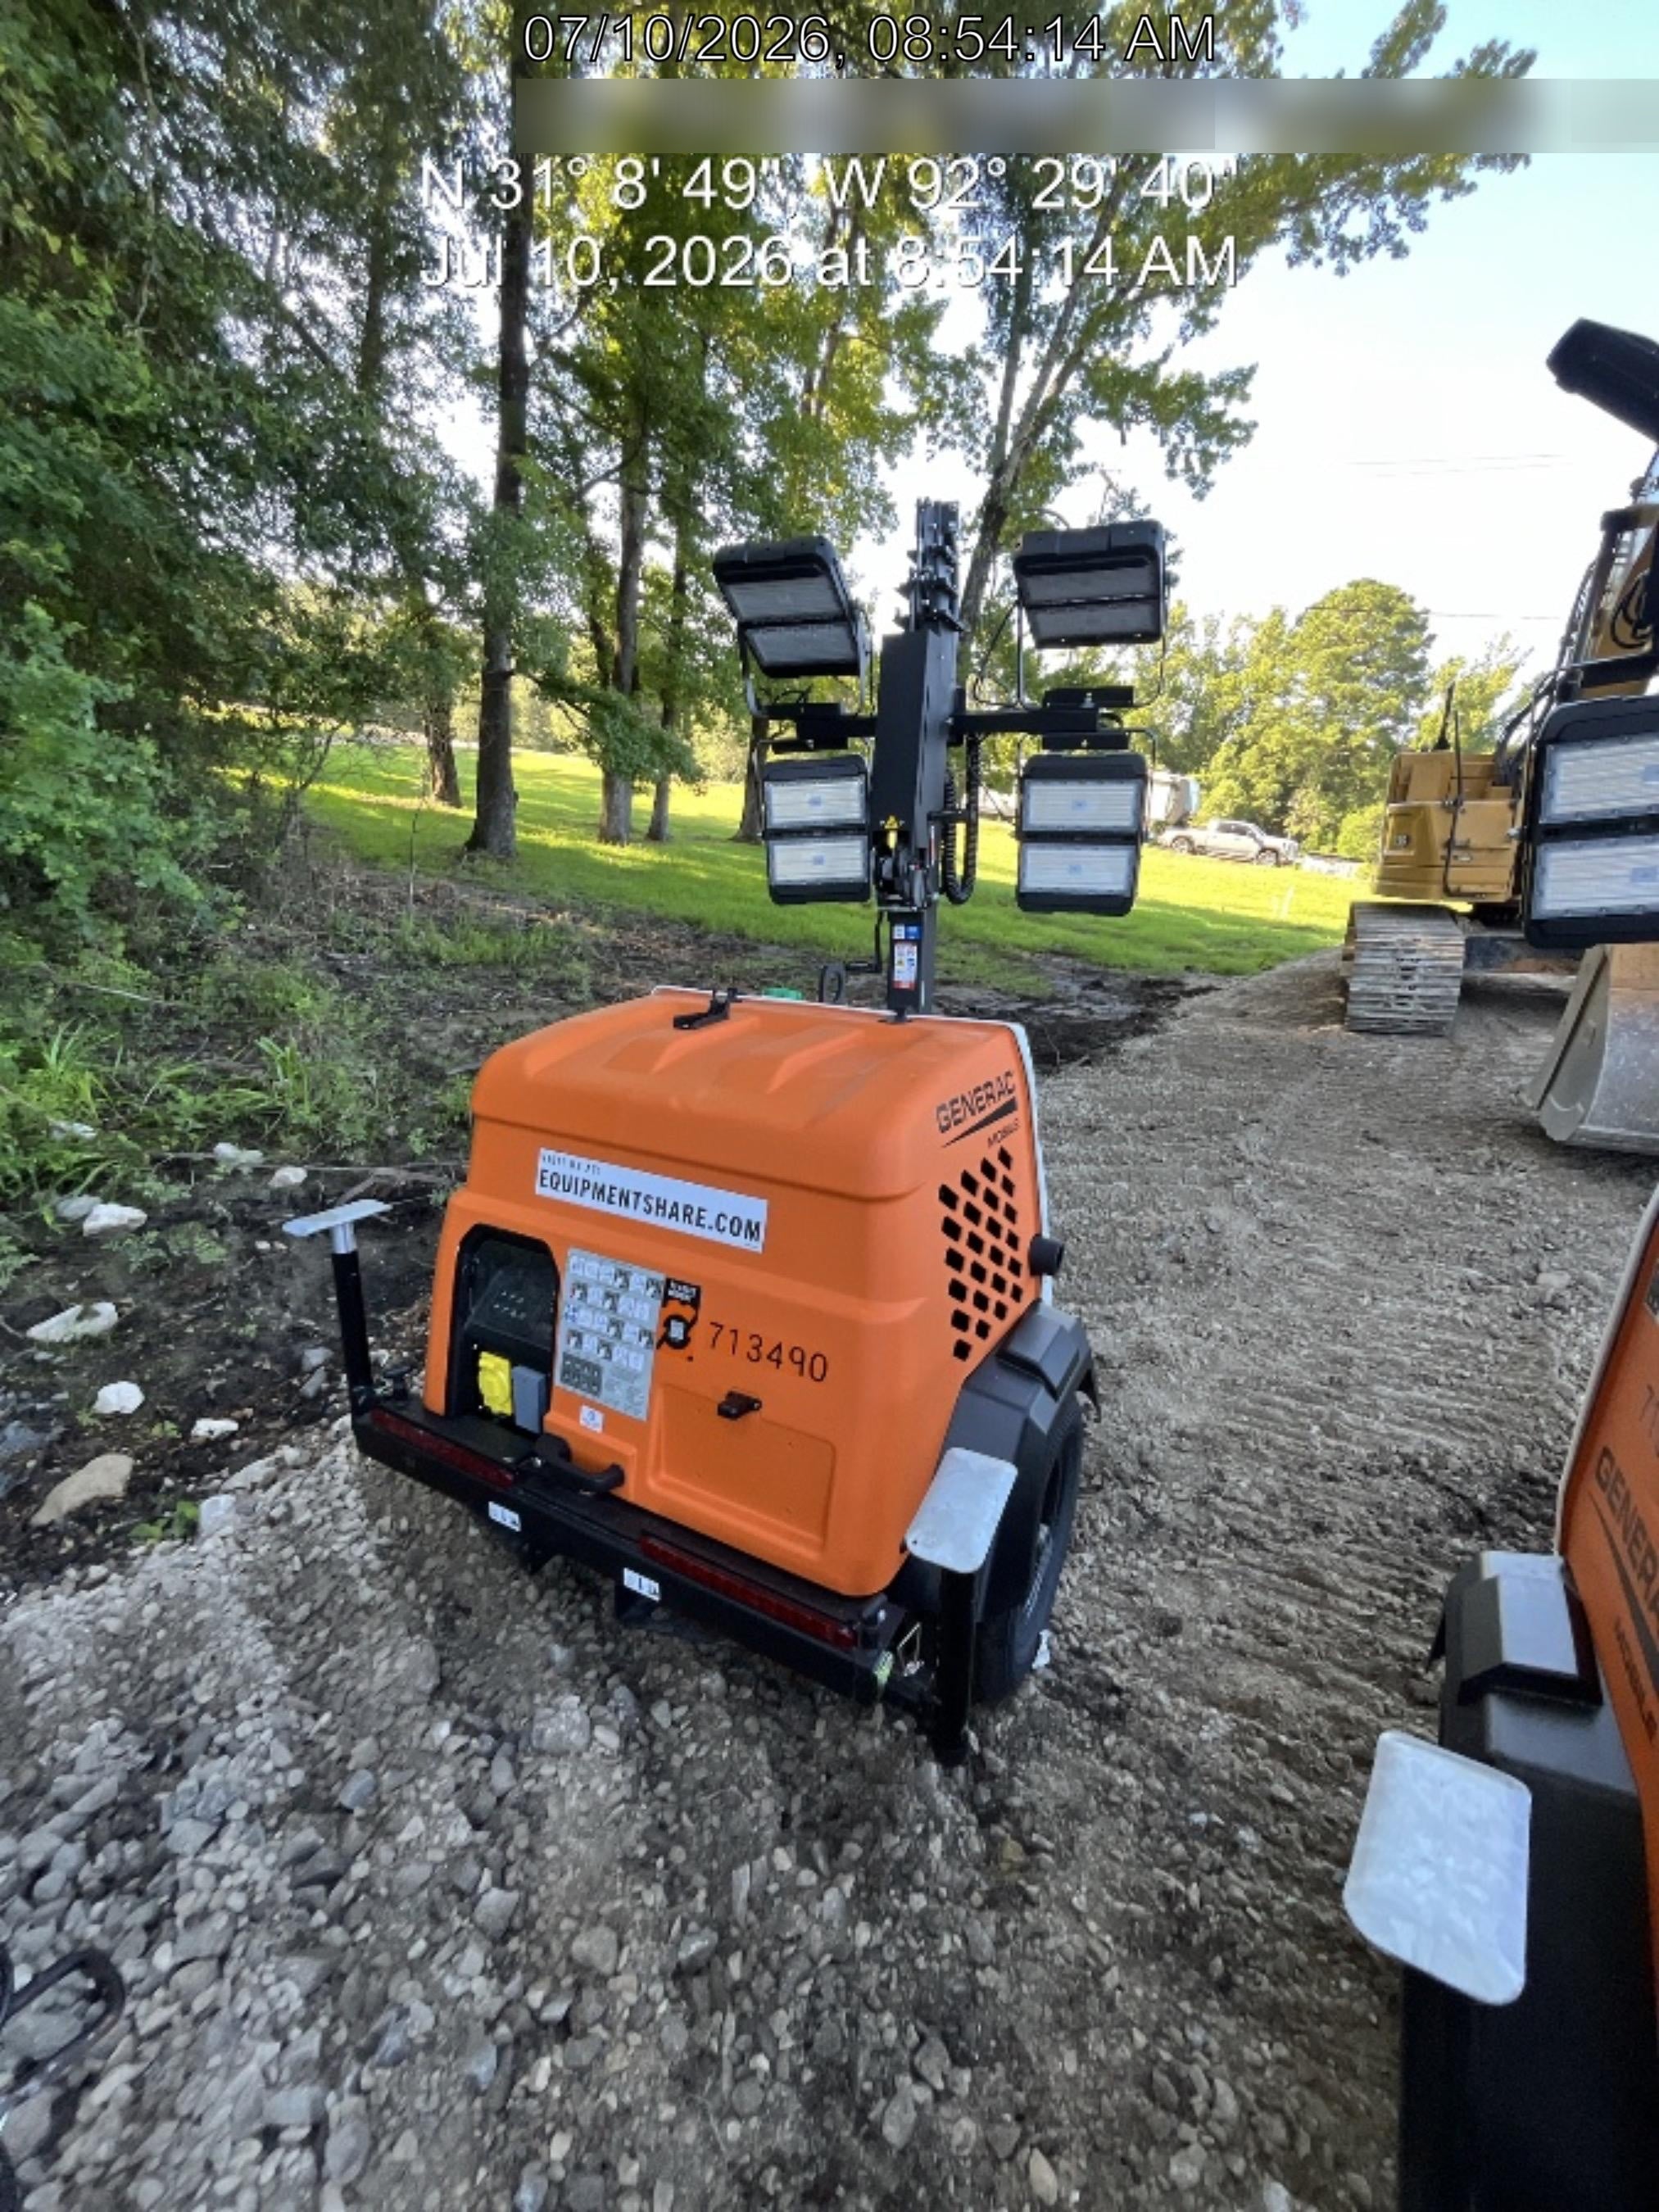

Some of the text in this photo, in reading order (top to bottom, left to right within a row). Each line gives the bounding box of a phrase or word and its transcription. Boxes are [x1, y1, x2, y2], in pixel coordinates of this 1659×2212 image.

[936, 1070, 1016, 1134] GENERAC
[539, 1169, 762, 1242] EQUIPMENTSHARE.COM
[709, 1321, 828, 1383] 713490
